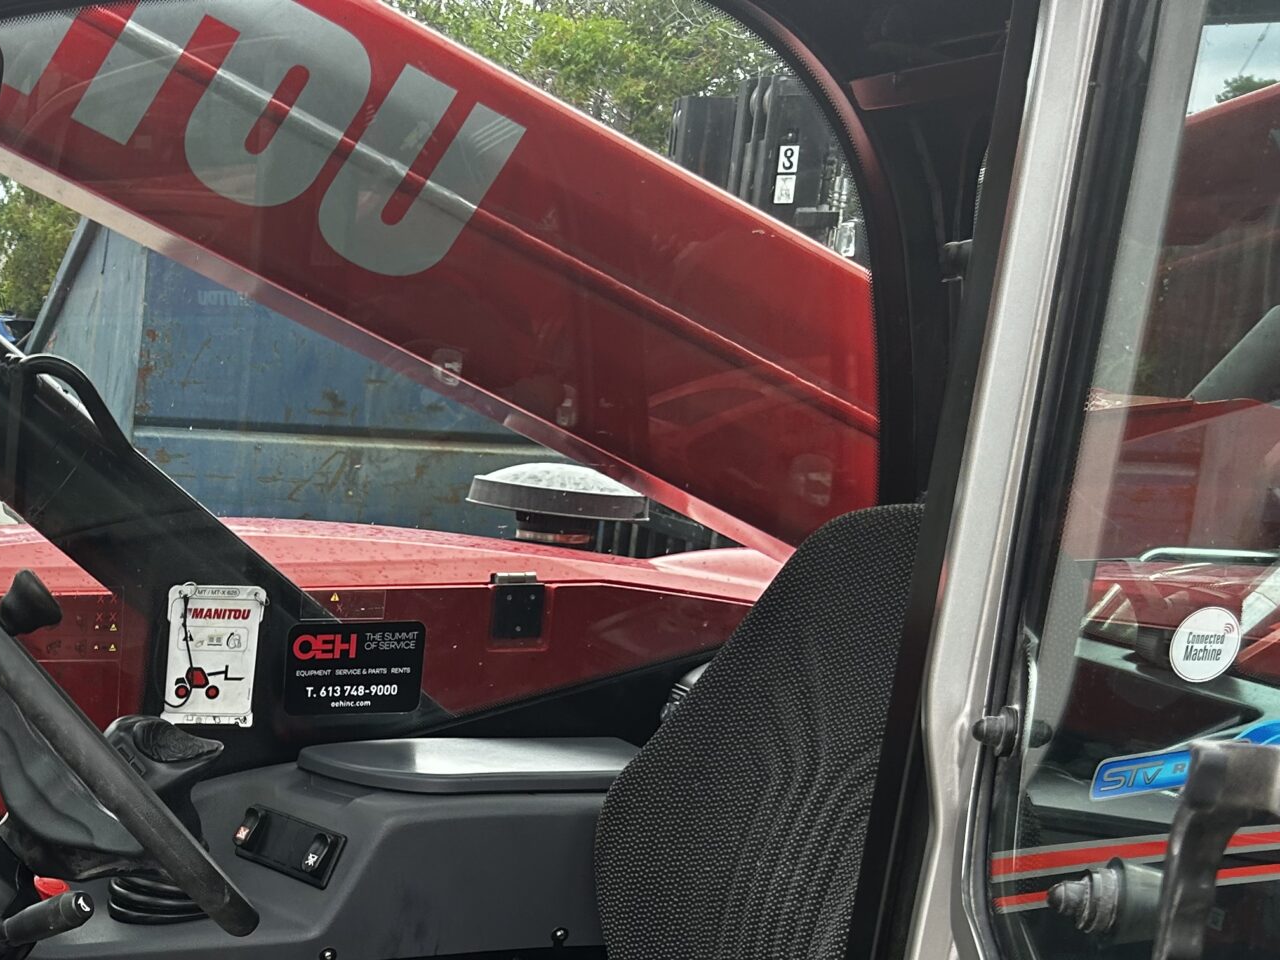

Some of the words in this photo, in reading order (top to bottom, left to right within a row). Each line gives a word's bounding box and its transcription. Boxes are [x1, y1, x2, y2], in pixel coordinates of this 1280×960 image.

[191, 608, 251, 620] MANITOU
[365, 632, 382, 641] THE
[384, 631, 419, 641] SUMMIT
[1186, 631, 1225, 645] Connected
[292, 633, 357, 660] OEH
[364, 642, 378, 650] OF
[378, 640, 416, 650] SERVICE
[1183, 646, 1222, 662] Machine
[296, 669, 332, 677] EQUIPMENT
[335, 668, 361, 676] SERVICE
[306, 687, 317, 698] T.
[319, 686, 341, 698] 613
[343, 684, 398, 697] 748-9000
[330, 700, 371, 708] oehinc.com
